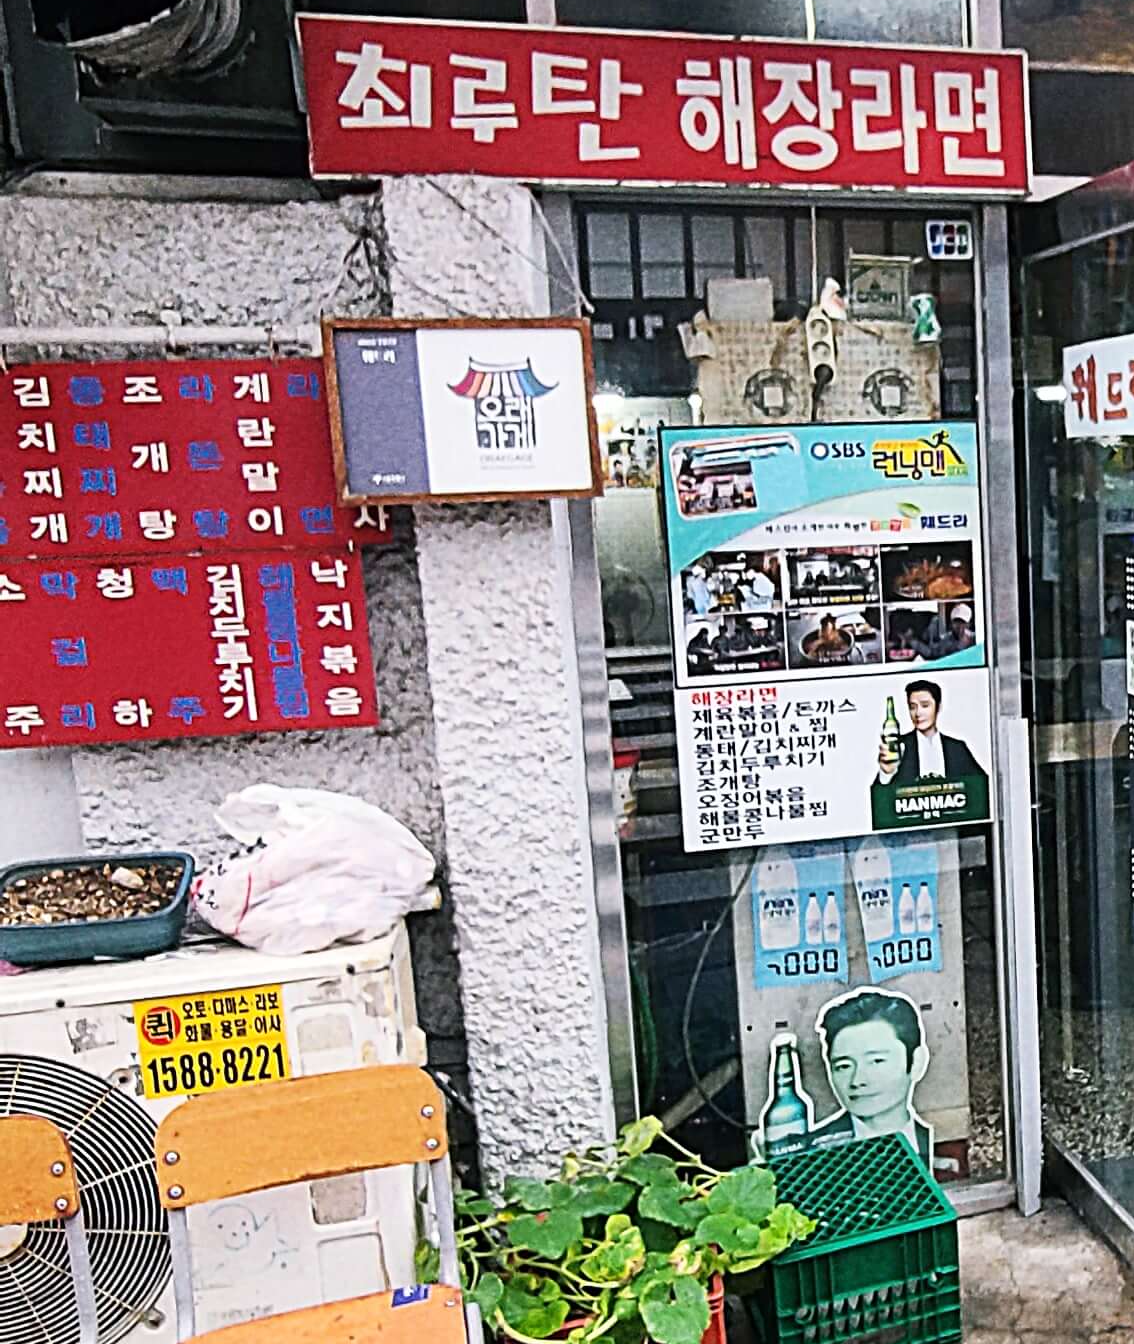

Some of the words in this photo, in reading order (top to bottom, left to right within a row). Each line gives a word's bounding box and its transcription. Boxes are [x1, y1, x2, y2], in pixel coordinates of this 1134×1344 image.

[335, 44, 643, 161] 최루탄
[676, 55, 1005, 176] 해장라면
[831, 442, 866, 458] SBS
[871, 449, 946, 481] 런닝맨
[311, 559, 363, 717] 낙지볶음
[691, 687, 778, 706] 해장라면
[694, 720, 780, 742] 계란말이
[696, 750, 826, 777] 김치두루치기
[696, 773, 761, 794] 조개탕
[697, 786, 807, 810] 오징어볶음
[895, 793, 967, 814] HANMAC
[700, 824, 766, 845] 군만두
[146, 1009, 176, 1041] 퀵
